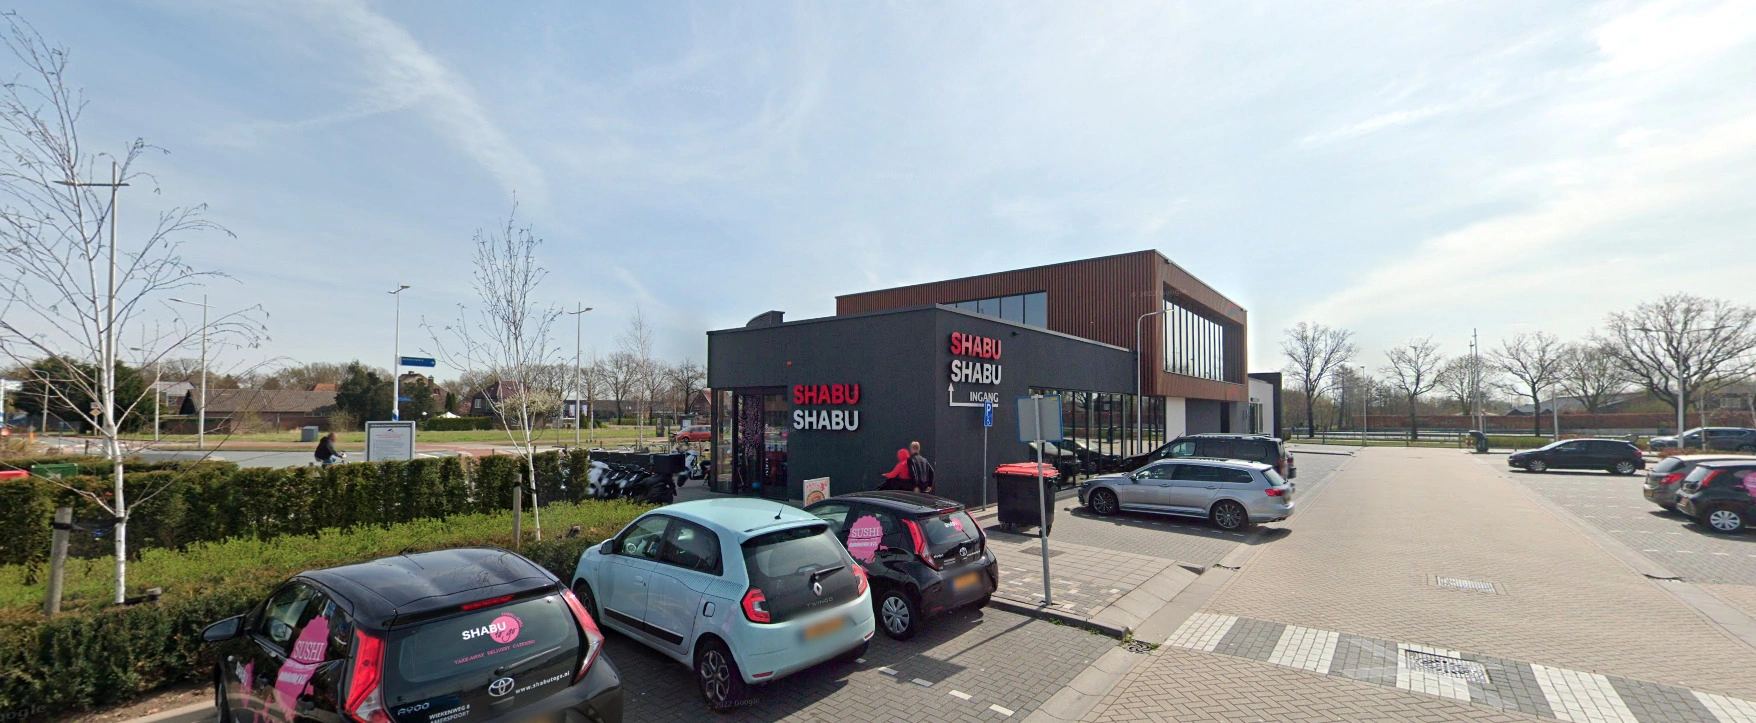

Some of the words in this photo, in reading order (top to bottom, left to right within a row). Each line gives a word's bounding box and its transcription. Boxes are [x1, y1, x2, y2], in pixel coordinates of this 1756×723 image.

[951, 331, 1001, 360] SHABU
[951, 359, 1001, 385] SHABU
[793, 384, 859, 405] SHABU
[970, 391, 999, 402] INGANG
[986, 403, 992, 416] P
[793, 409, 859, 431] SHABU
[851, 527, 880, 538] SUSHI
[806, 596, 834, 607] TWINGO
[462, 621, 507, 641] SHABU
[293, 640, 325, 660] SUSHI
[454, 652, 485, 665] TAKE-AWAY
[487, 645, 511, 656] DELIVERY
[429, 705, 466, 720] WIEKENWEG
